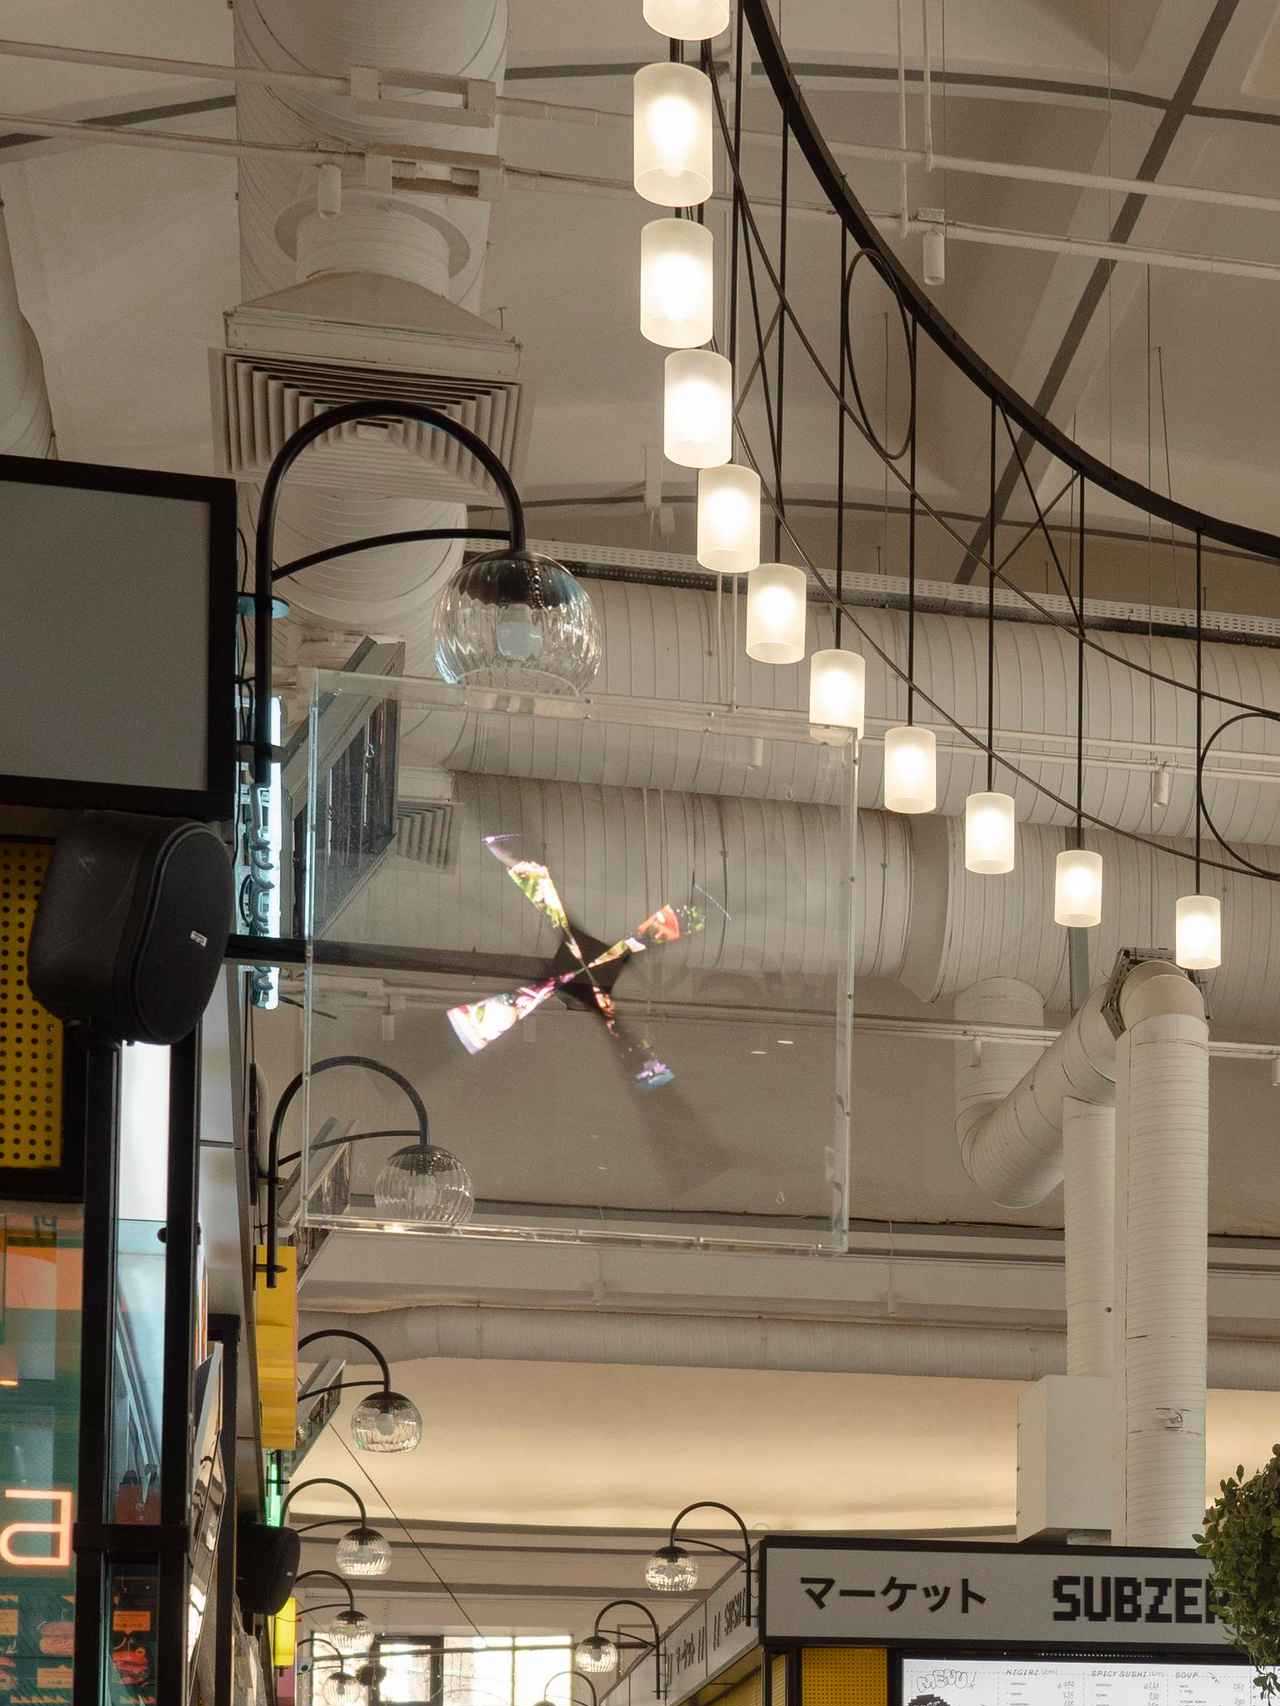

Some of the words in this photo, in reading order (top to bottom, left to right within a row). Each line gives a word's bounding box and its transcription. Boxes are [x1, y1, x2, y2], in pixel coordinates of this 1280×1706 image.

[800, 1575, 986, 1613] マーケット
